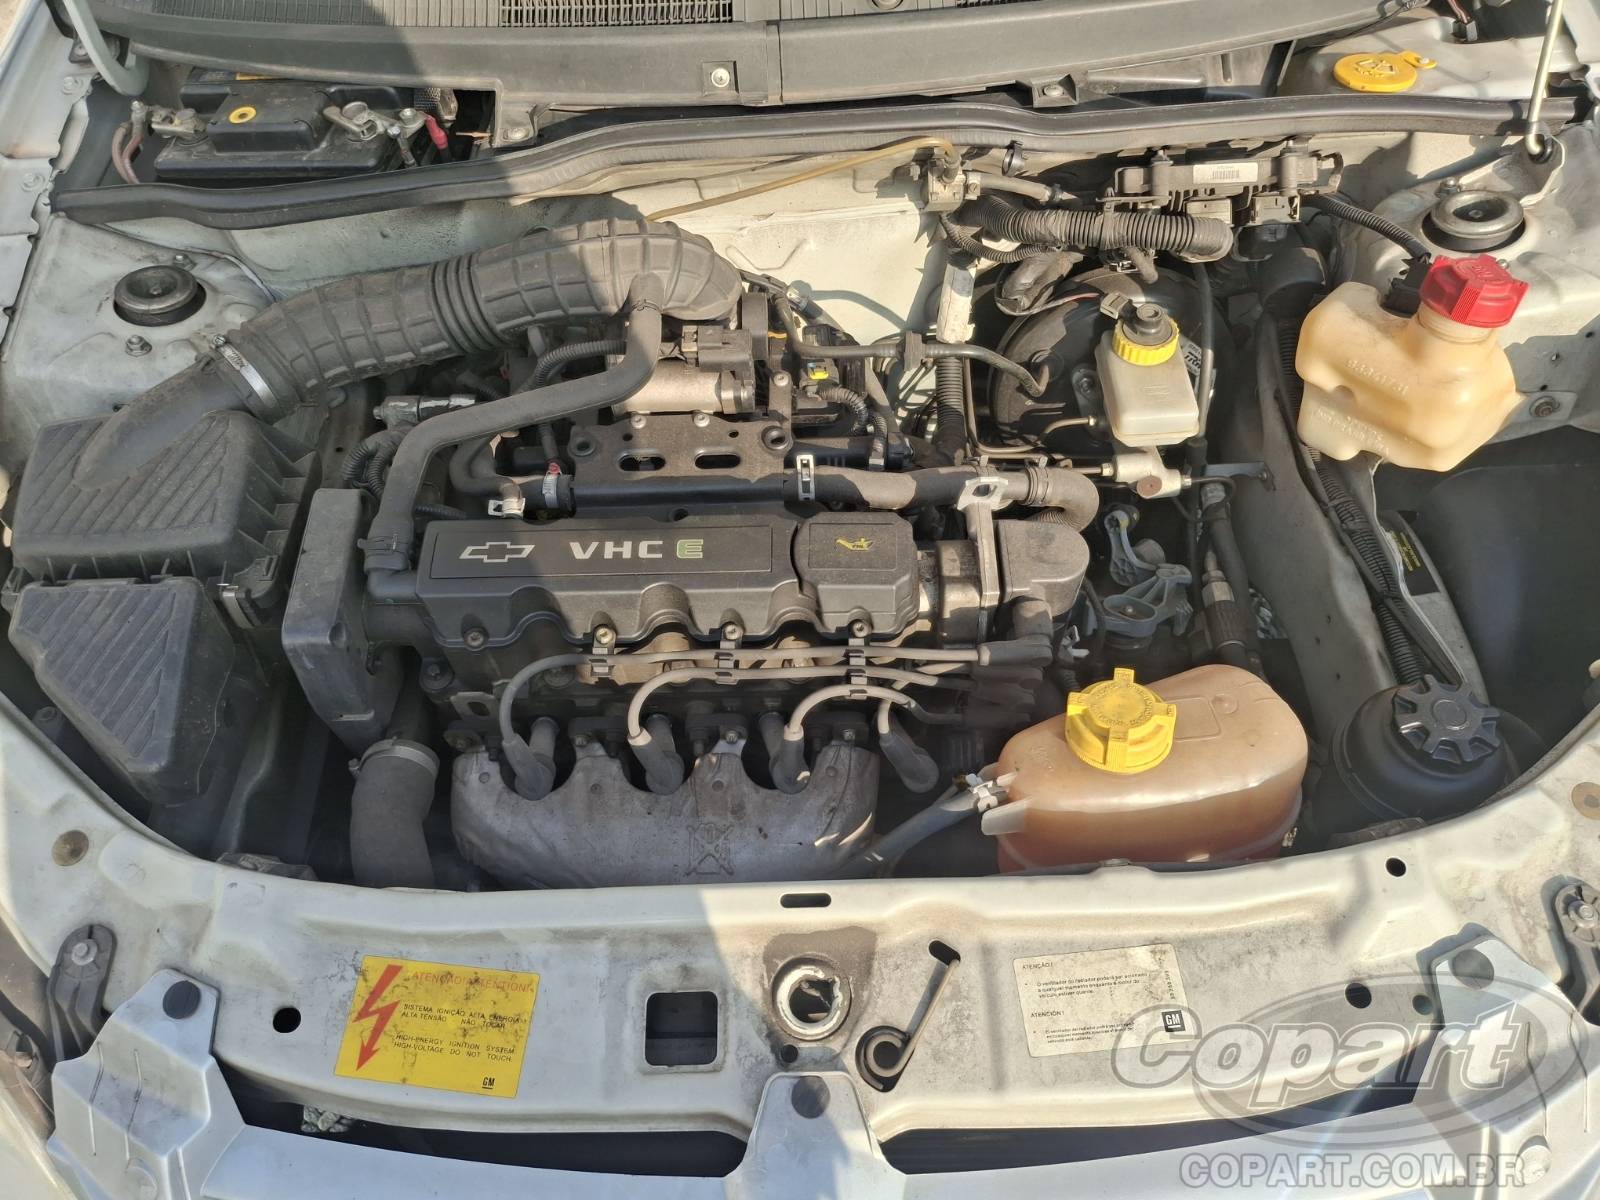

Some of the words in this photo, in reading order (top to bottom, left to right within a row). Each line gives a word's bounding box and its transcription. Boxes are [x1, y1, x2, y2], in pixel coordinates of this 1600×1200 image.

[569, 540, 663, 560] VHC
[676, 539, 704, 559] E
[404, 1003, 432, 1013] SISTEMA
[437, 1007, 466, 1017] IGNIÇÃO
[401, 1010, 418, 1019] ALTA
[461, 1017, 476, 1026] NÃO
[1165, 1014, 1180, 1025] GM
[393, 1041, 444, 1053] HIGH-VOLTAGE
[449, 1048, 461, 1056] DO
[449, 1040, 480, 1050] IGNITION
[486, 1044, 515, 1054] SYSTEM
[481, 1076, 496, 1088] GM
